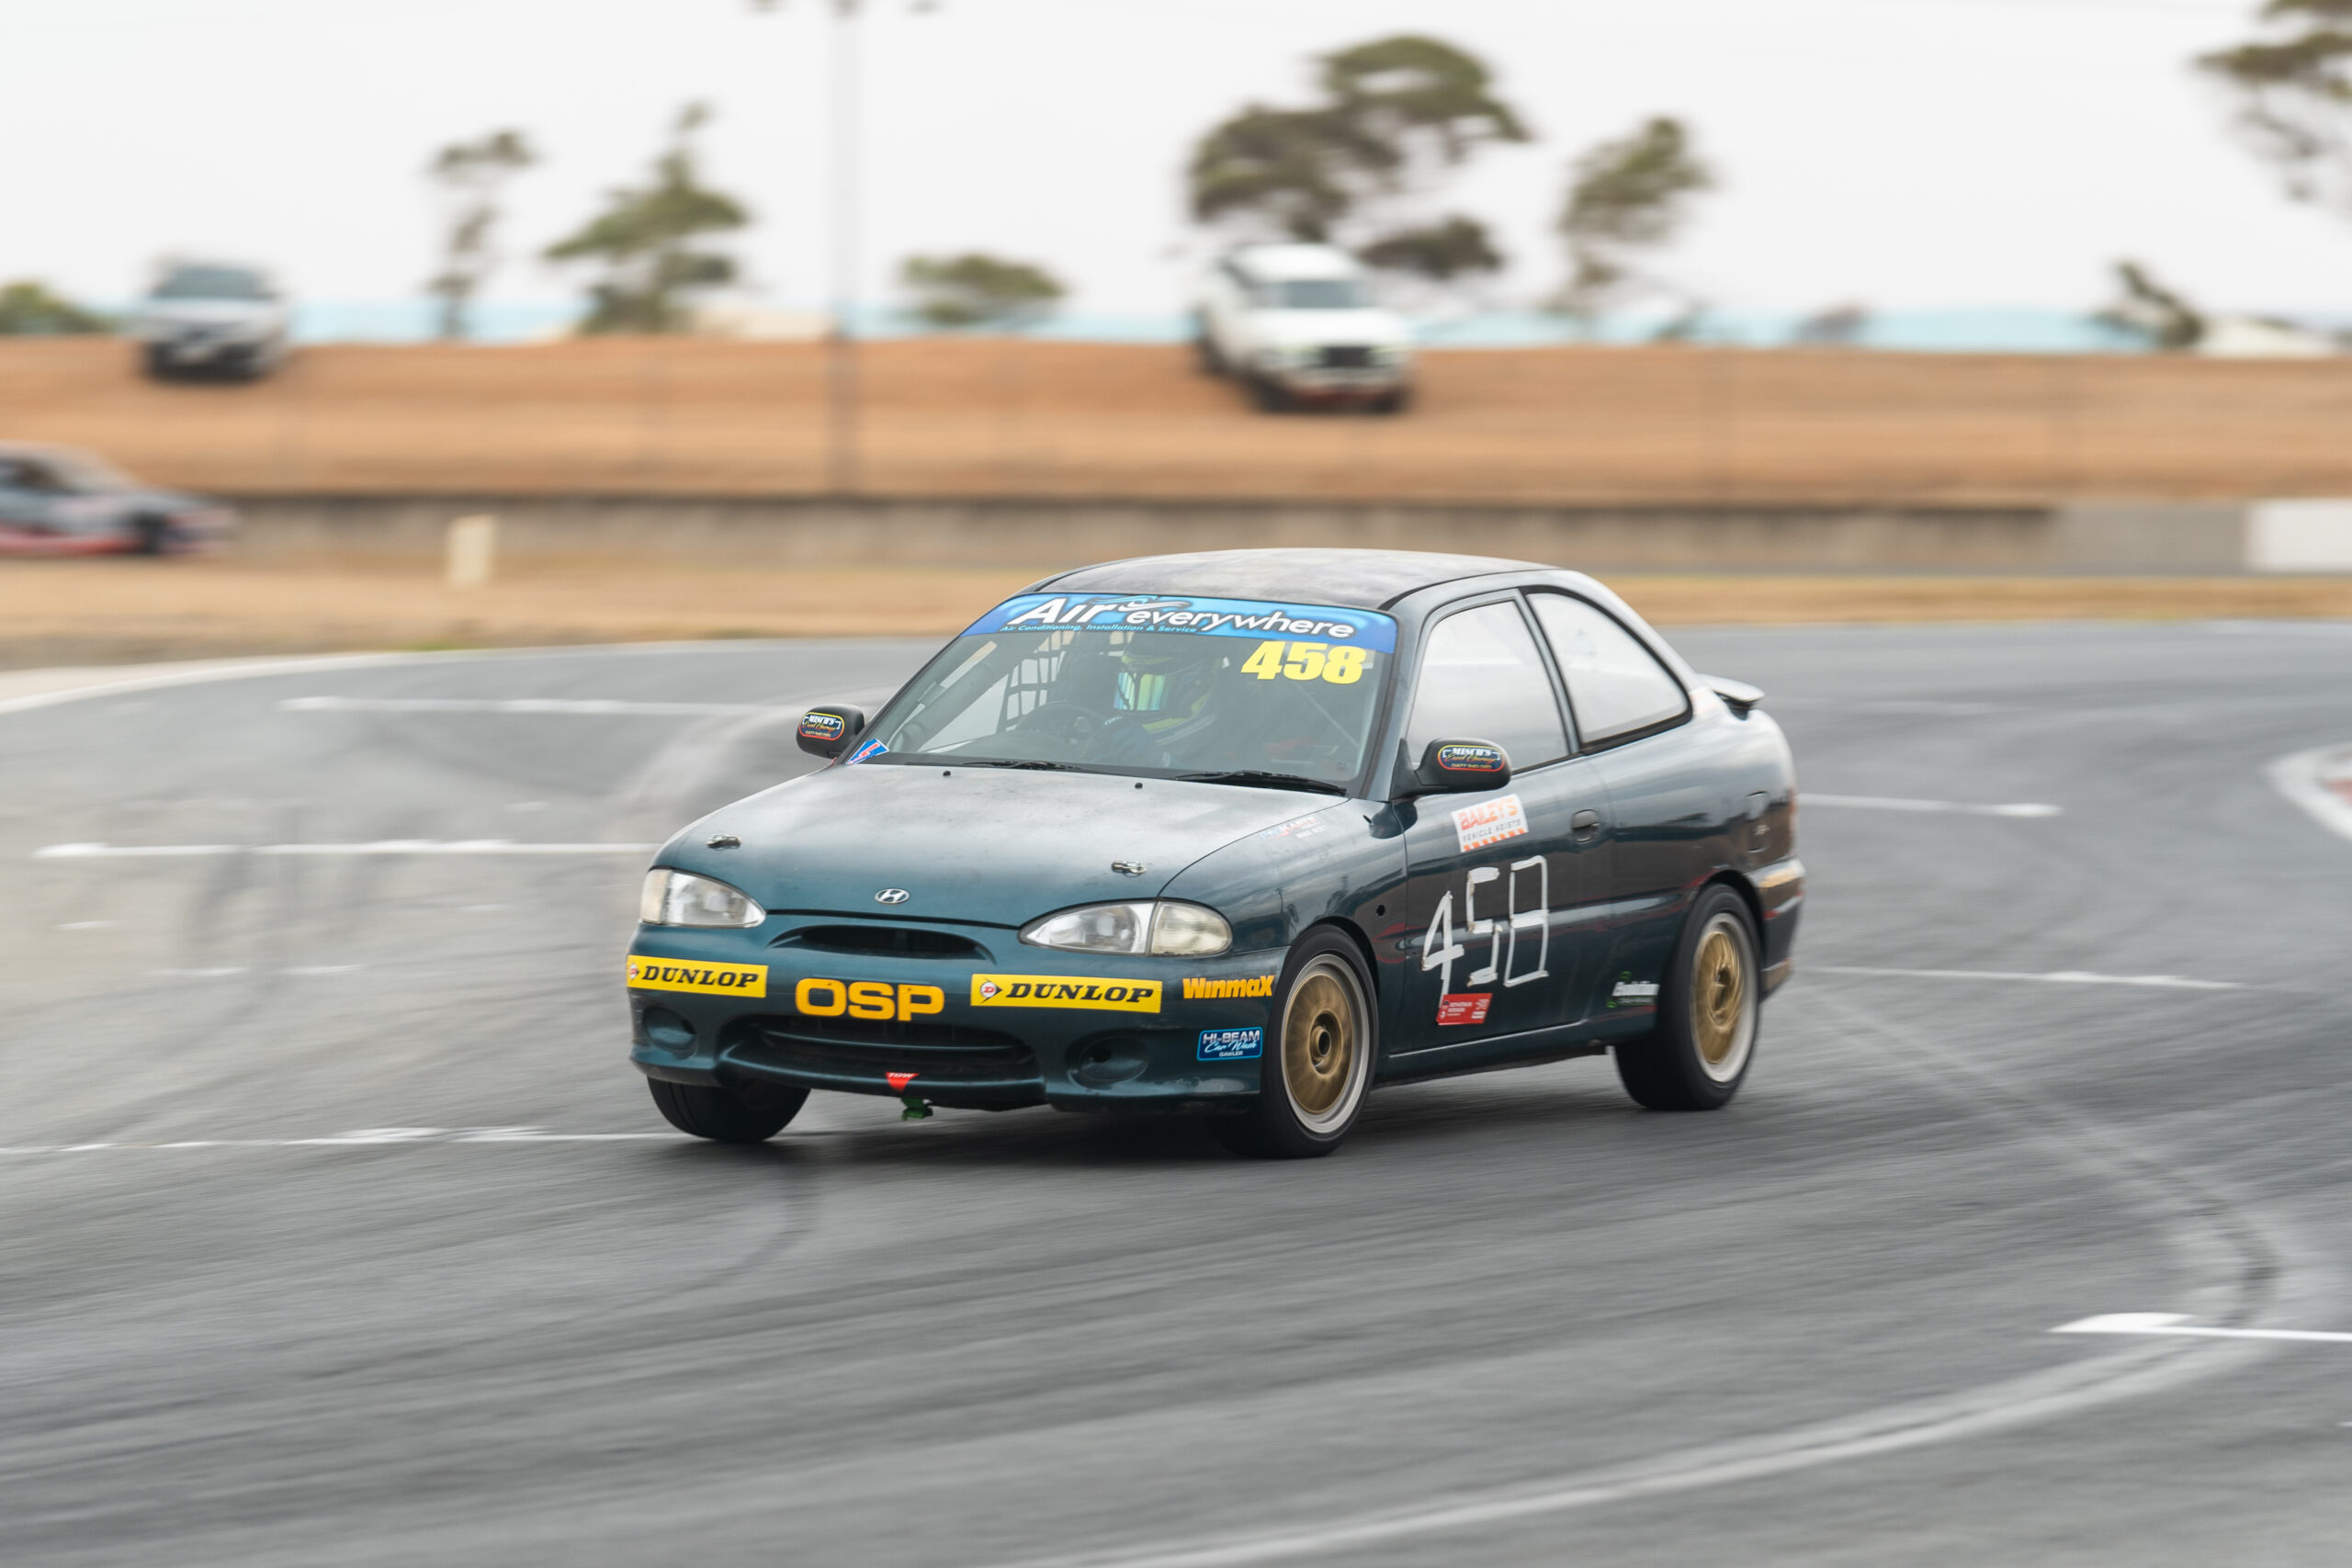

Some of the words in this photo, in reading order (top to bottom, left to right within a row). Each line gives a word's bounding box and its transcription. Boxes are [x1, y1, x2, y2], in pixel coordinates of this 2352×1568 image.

[1007, 598, 1119, 625] Air
[1126, 610, 1355, 639] everywhere
[1018, 624, 1082, 632] Conditioning,
[1086, 624, 1144, 632] Installation
[1159, 625, 1197, 634] Service
[1240, 640, 1367, 685] 458
[1420, 854, 1550, 1009] 458
[642, 965, 759, 987] DUNLOP
[795, 977, 945, 1021] OSP
[1006, 983, 1154, 1003] DUNLOP
[1203, 1030, 1261, 1044] HI-BEAM
[1204, 1041, 1227, 1054] Car
[1227, 1039, 1258, 1052] Wash
